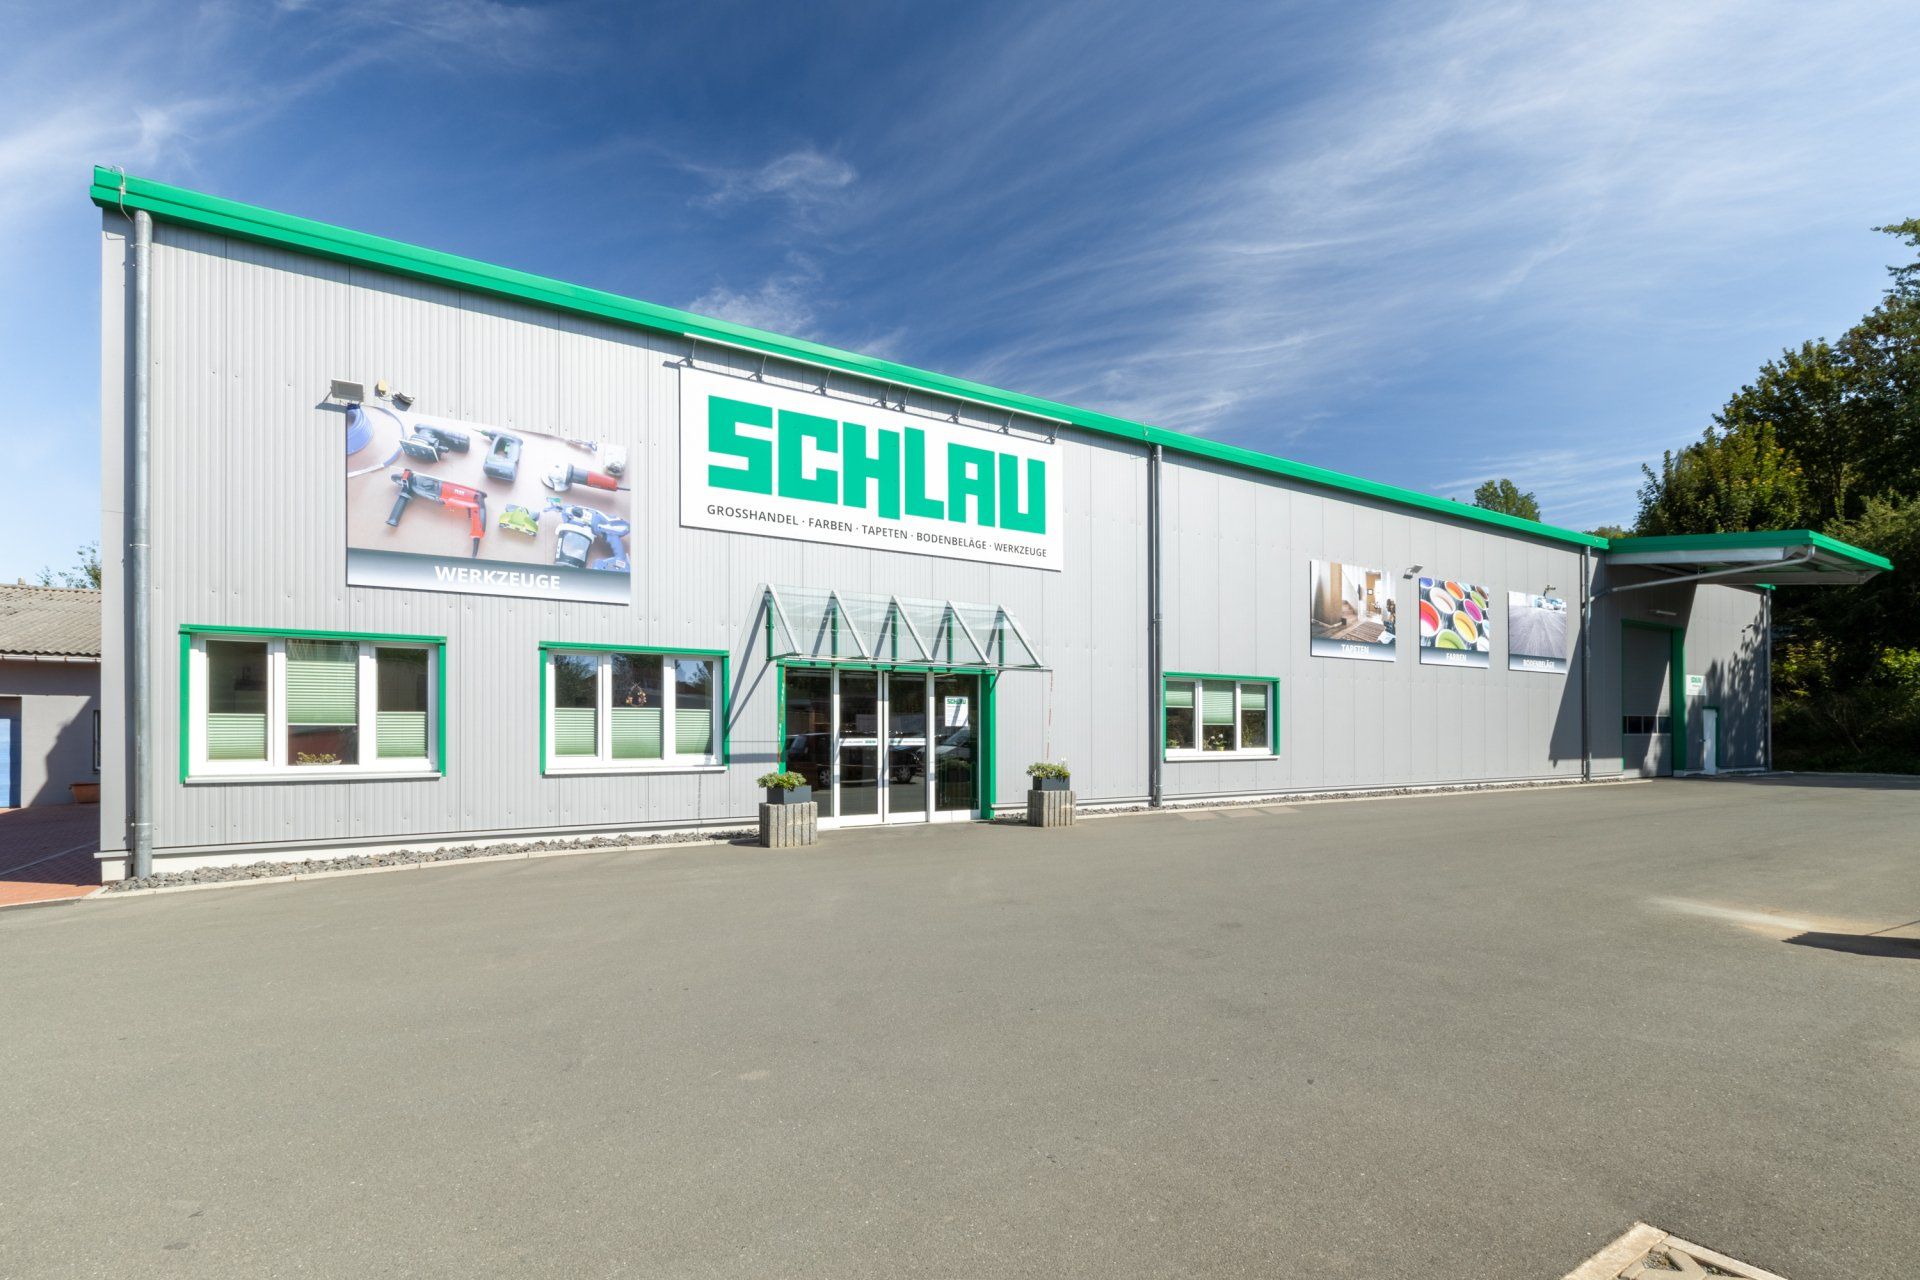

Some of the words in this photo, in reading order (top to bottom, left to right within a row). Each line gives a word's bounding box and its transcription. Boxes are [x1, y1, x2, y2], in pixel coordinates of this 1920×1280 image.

[708, 395, 1045, 535] SCHLAU
[707, 504, 798, 526] GROSSHANDEL
[809, 517, 852, 533] FARBEN
[861, 524, 908, 540] TAPETEN
[916, 531, 987, 551] BODENBELÄGE
[994, 542, 1047, 558] WERKZEUGE
[434, 566, 560, 590] WERKZEUGE
